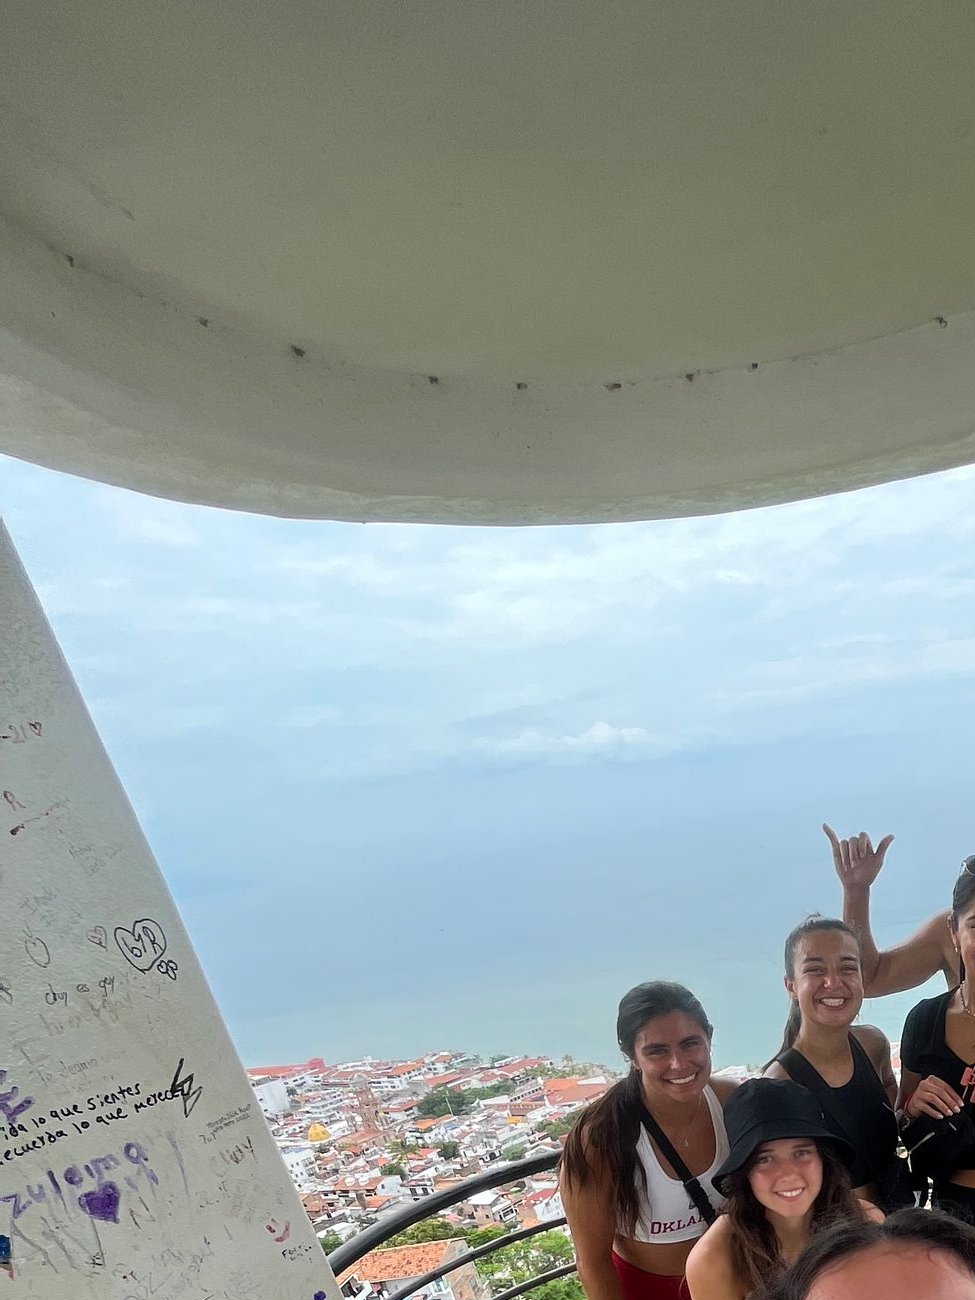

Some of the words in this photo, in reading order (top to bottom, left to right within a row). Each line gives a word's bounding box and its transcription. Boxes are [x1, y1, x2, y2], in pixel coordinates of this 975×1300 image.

[0, 1123, 28, 1140] ida
[32, 1116, 46, 1128] lo
[50, 1104, 83, 1120] que
[87, 1082, 141, 1111] sientes
[0, 1129, 68, 1165] ecuerda
[72, 1121, 91, 1134] lo
[96, 1107, 128, 1126] que
